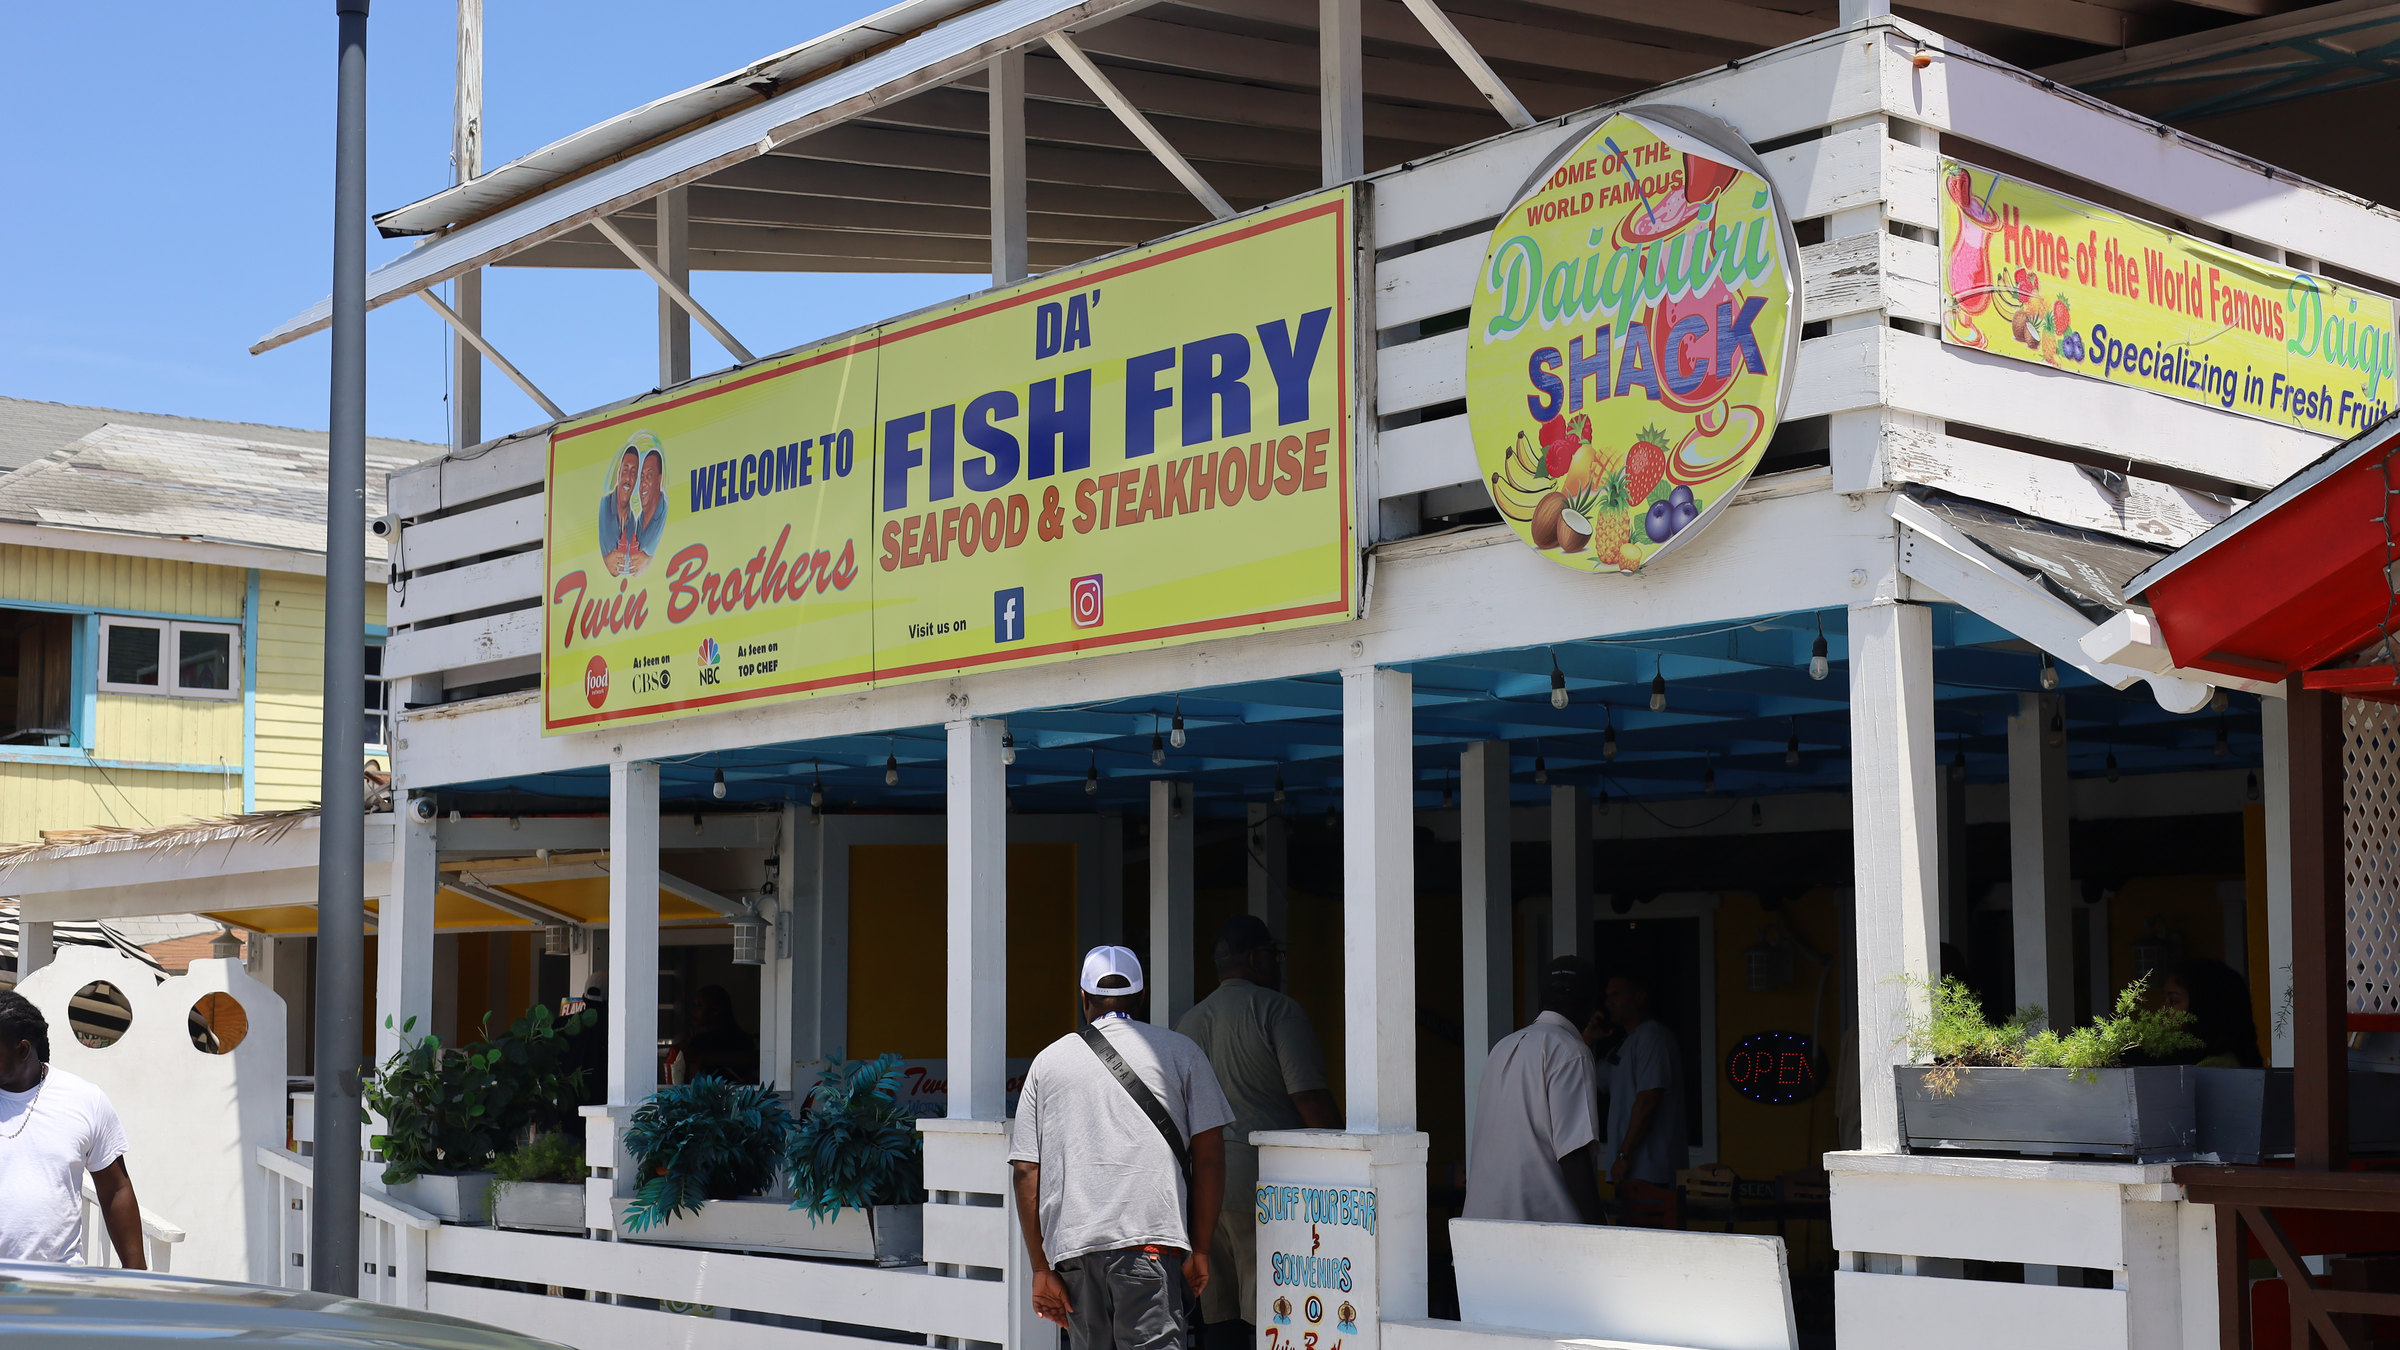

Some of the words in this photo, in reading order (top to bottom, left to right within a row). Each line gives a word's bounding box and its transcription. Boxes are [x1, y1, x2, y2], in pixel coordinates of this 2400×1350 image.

[1601, 151, 1628, 176] OF
[1633, 141, 1671, 167] THE
[1527, 192, 1594, 227] WORLD
[1599, 169, 1684, 209] FAMOUS
[1485, 188, 1772, 342] Daiquiri
[2002, 203, 2070, 280] Home
[2076, 230, 2098, 287] of
[2104, 237, 2140, 298] the
[2144, 247, 2204, 319] World
[2208, 267, 2285, 342] Famous
[1036, 289, 1101, 361] DA'
[1527, 296, 1769, 424] SHACK
[2089, 323, 2237, 408] Specializing
[2245, 365, 2264, 404] in
[2270, 372, 2332, 423] Fresh
[2339, 389, 2390, 431] Fruit
[883, 368, 1092, 512] FISH
[1125, 307, 1333, 459] FRY
[690, 438, 814, 513] WELCOME
[819, 428, 854, 481] TO
[879, 493, 1030, 572] SEAFOOD
[1037, 485, 1065, 543] &
[1072, 427, 1331, 535] STEAKHOUSE
[553, 570, 649, 649] Twin
[665, 523, 859, 625] Brothers
[738, 645, 747, 658] As
[748, 643, 766, 656] Seen
[767, 641, 778, 653] on
[908, 622, 934, 639] Visit
[936, 621, 950, 636] us
[953, 619, 968, 632] on
[586, 667, 609, 697] food
[632, 670, 660, 695] CBS
[633, 657, 642, 669] As
[643, 655, 660, 668] Seen
[661, 655, 670, 665] on
[699, 666, 720, 687] NBC
[738, 663, 755, 678] TOP
[756, 659, 779, 674] CHEF
[1256, 1185, 1299, 1225] STUFF
[1302, 1188, 1339, 1225] YOUR
[1339, 1189, 1377, 1236] BEAR
[1272, 1251, 1352, 1293] SOUVENIRS
